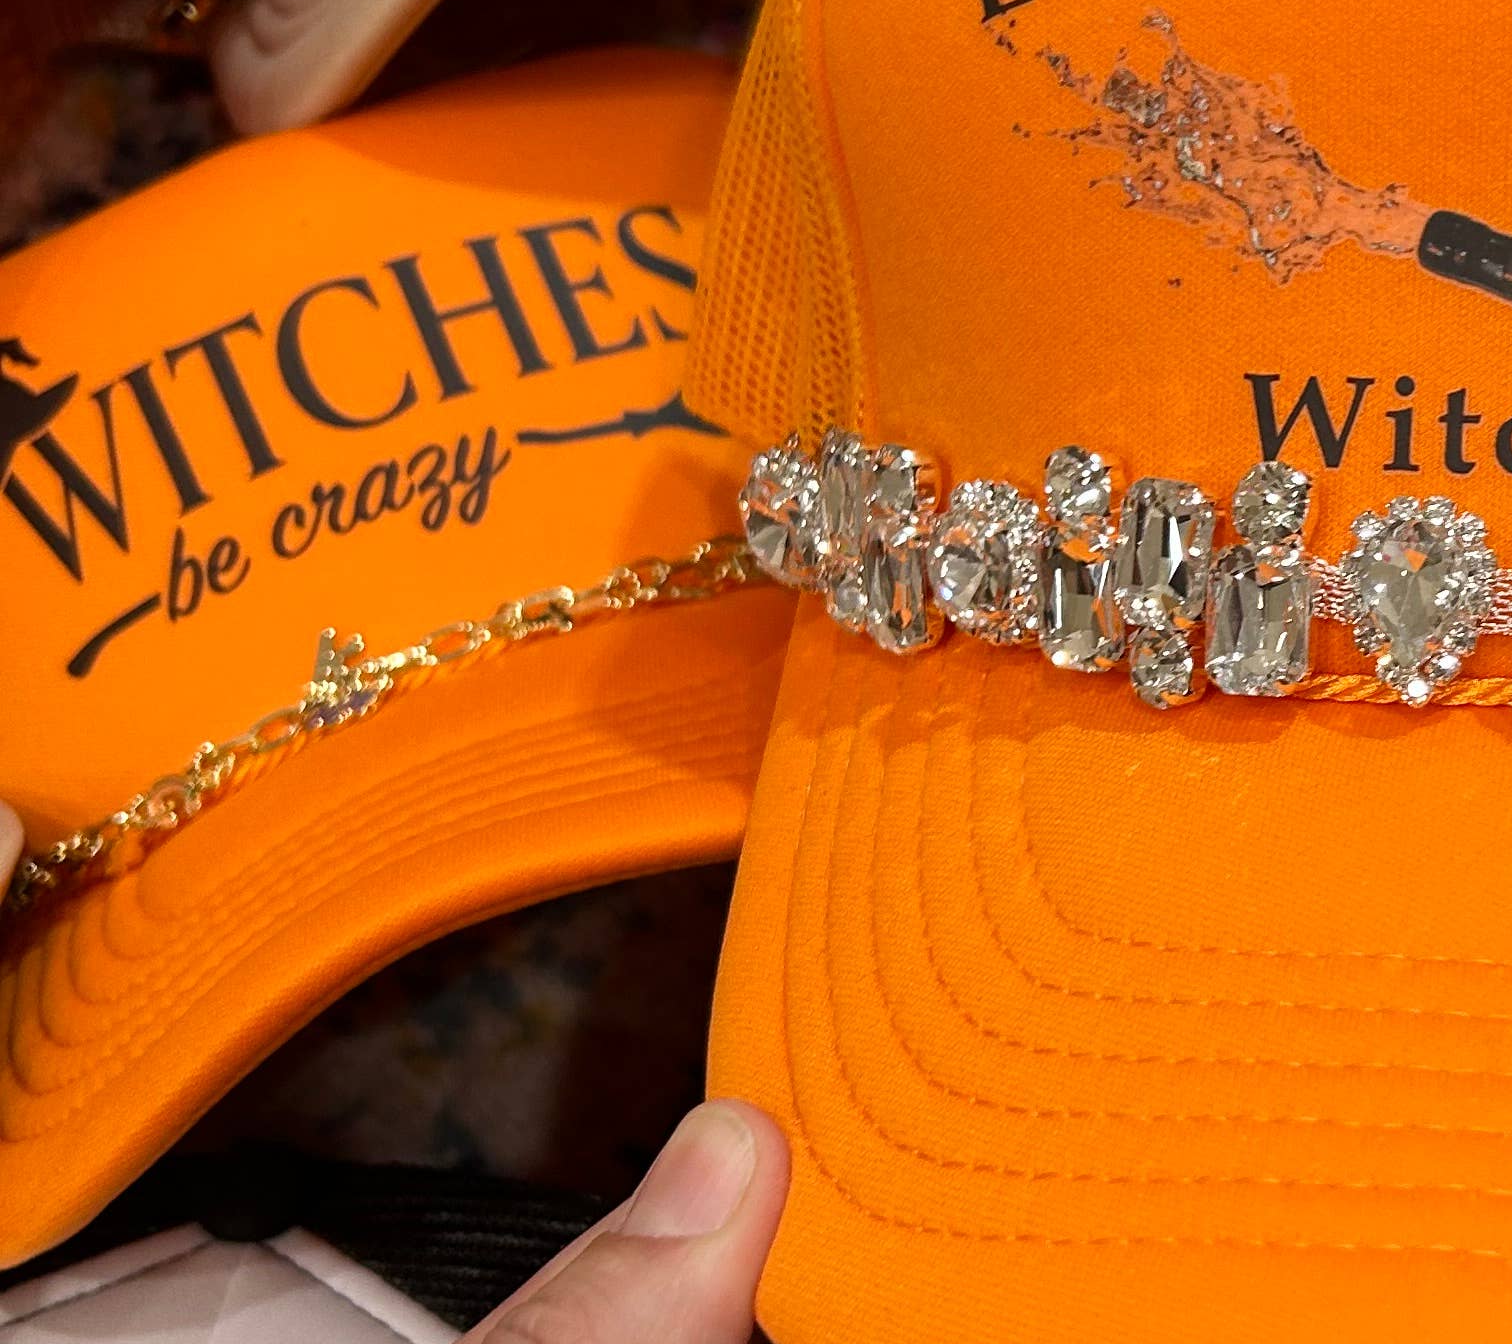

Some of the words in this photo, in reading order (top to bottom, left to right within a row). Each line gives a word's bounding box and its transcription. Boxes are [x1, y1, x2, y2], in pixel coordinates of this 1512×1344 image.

[2, 204, 698, 582] WITCHES
[165, 527, 252, 623] be
[271, 426, 512, 558] crazy
